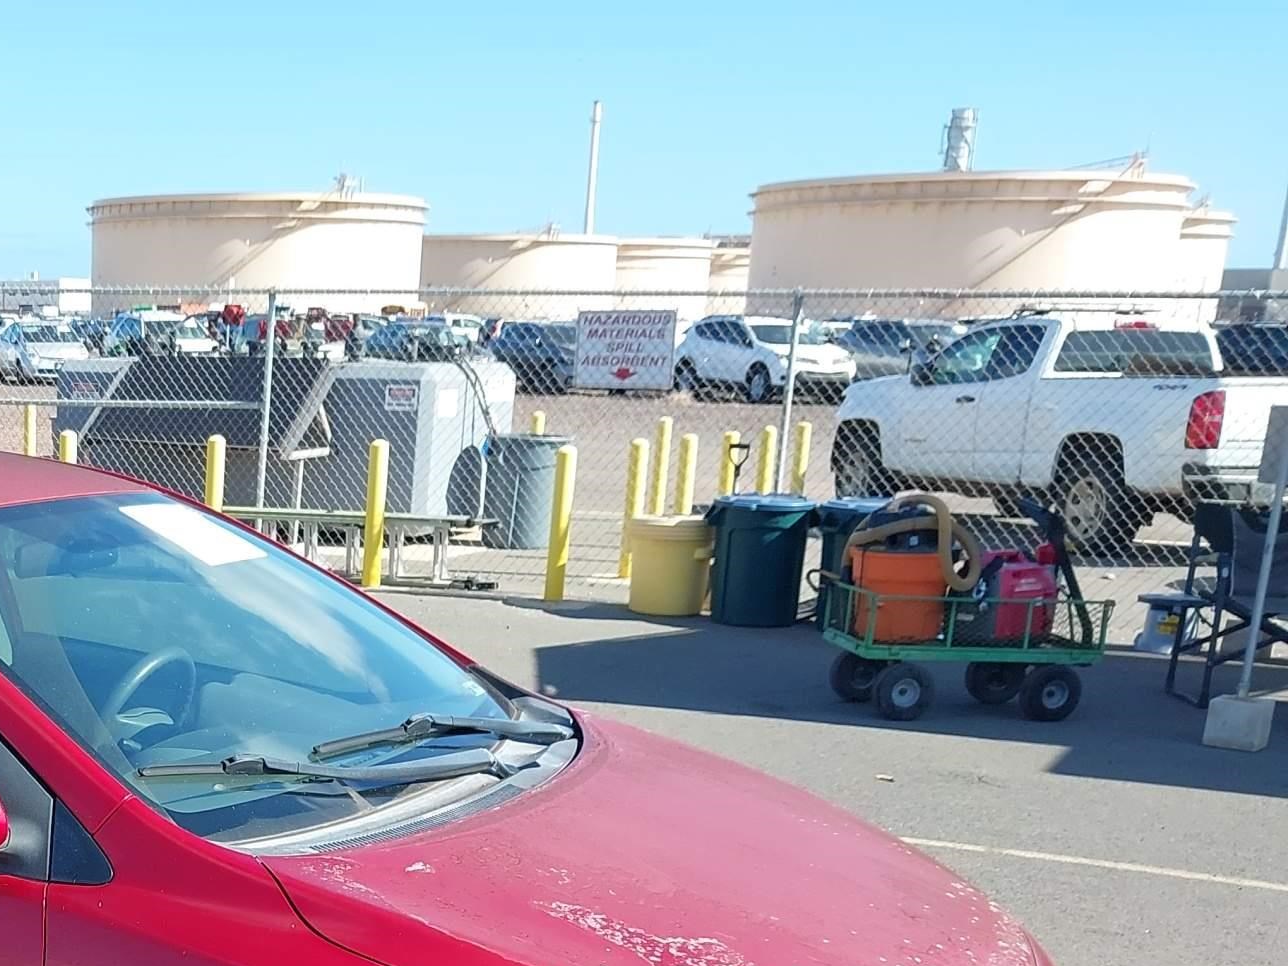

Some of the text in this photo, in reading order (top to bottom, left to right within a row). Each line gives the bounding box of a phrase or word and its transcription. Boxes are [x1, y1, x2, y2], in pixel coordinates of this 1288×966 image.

[583, 314, 672, 326] HAZARDOUS
[586, 327, 665, 340] MATERIALS
[606, 341, 643, 353] SPILL
[581, 355, 667, 367] ABSORBENT
